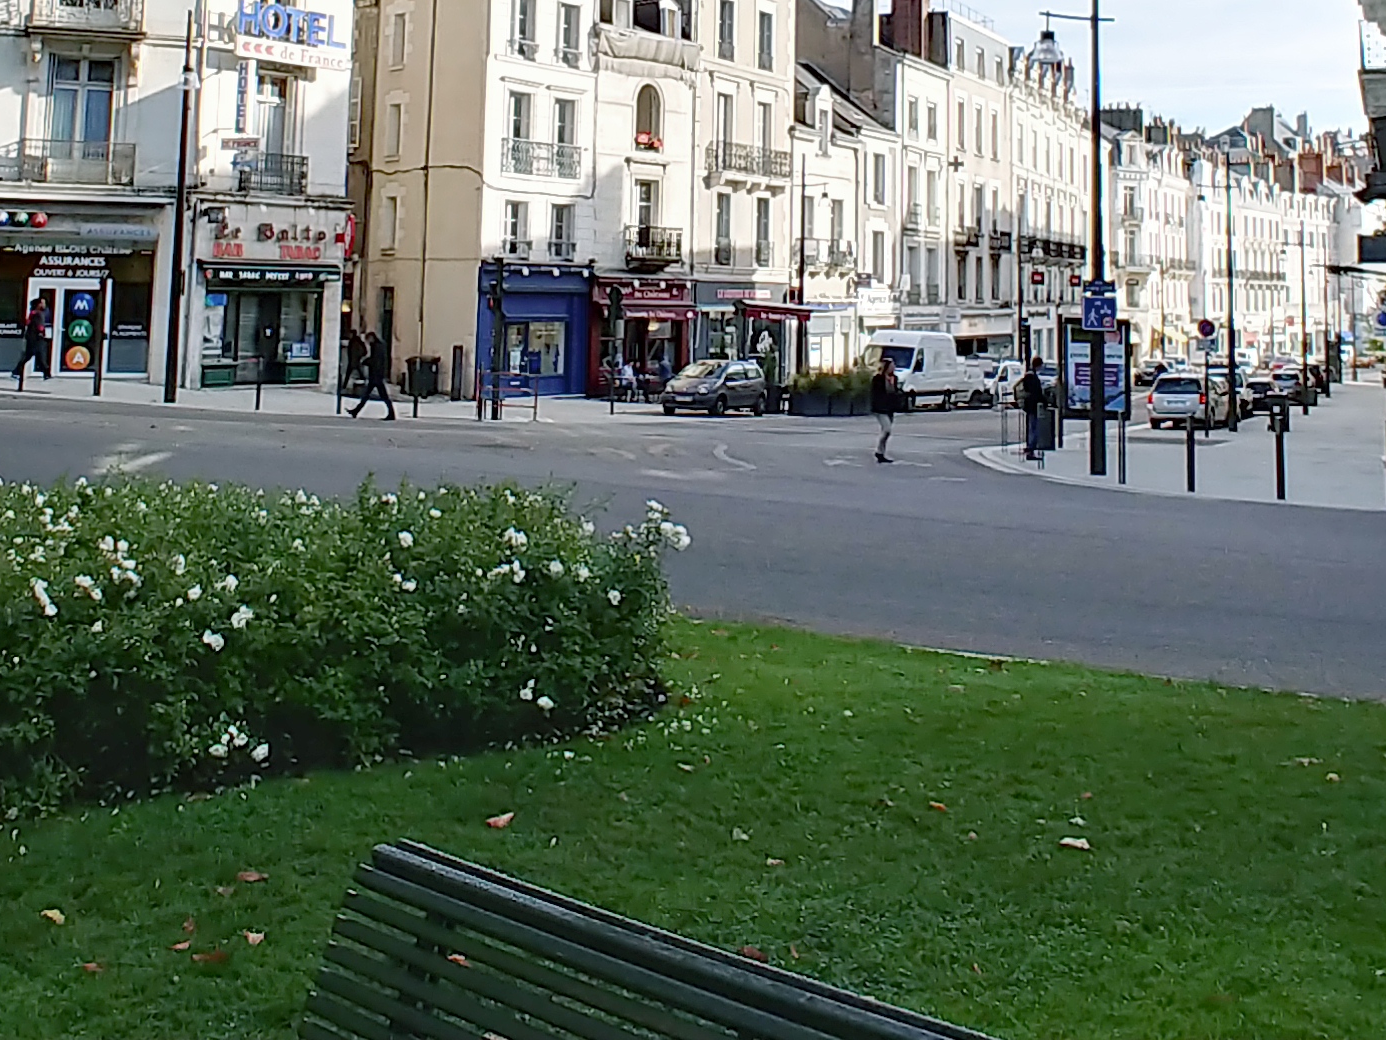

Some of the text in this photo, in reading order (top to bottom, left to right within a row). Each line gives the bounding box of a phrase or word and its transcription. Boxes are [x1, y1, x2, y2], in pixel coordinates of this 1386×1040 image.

[280, 46, 344, 68] de France
[237, 61, 248, 132] HOTEL
[86, 227, 151, 237] ASSURANCES
[213, 243, 321, 260] BAR TABAC
[39, 256, 105, 266] ASSURANCES
[34, 269, 65, 277] OUVERT
